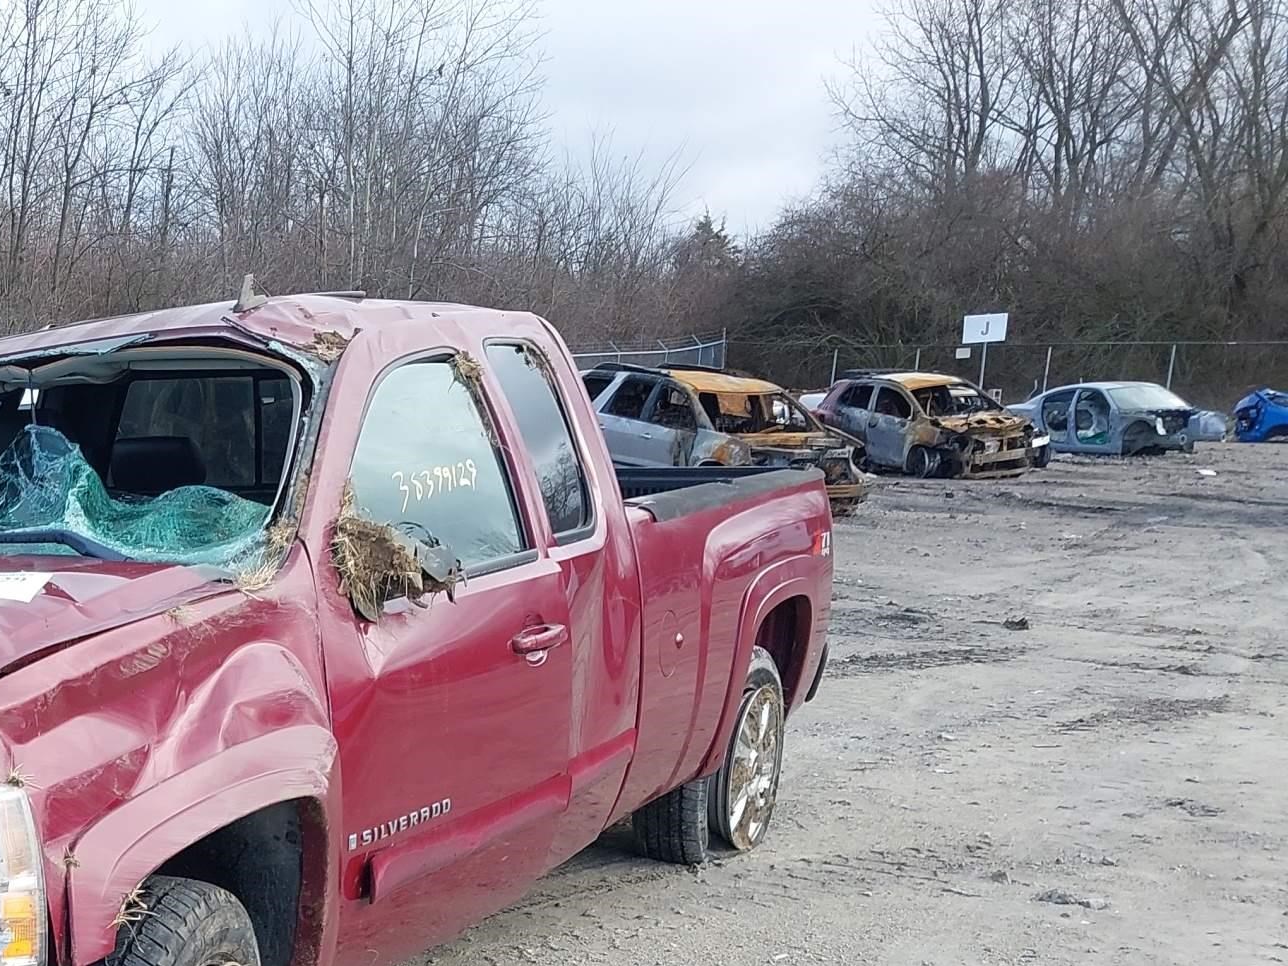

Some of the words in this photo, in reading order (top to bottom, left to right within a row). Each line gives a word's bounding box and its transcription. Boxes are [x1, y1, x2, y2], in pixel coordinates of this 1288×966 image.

[980, 321, 990, 336] J
[391, 458, 477, 513] 38399129
[361, 798, 452, 847] SILVERADO
